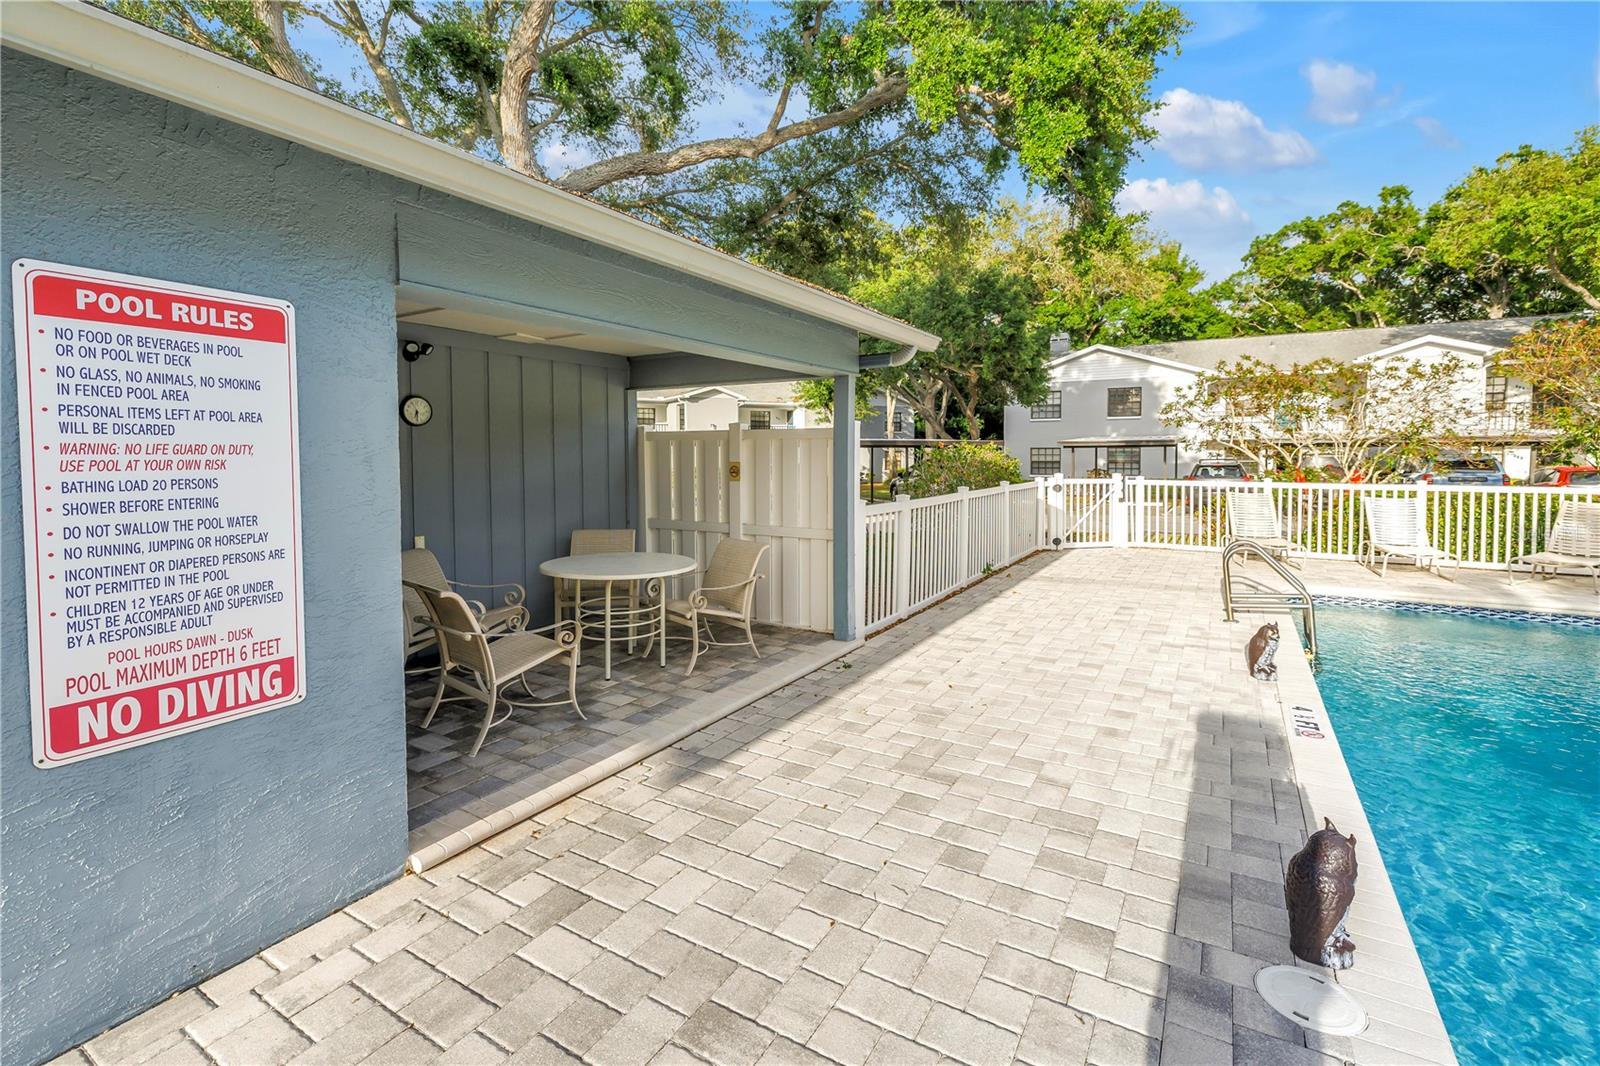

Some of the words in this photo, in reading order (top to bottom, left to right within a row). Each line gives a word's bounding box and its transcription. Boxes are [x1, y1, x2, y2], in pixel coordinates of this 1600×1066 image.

[76, 288, 162, 320] POOL
[171, 302, 254, 331] RULES
[54, 327, 74, 341] NO
[78, 330, 112, 344] FOOD
[116, 334, 134, 346] OR
[137, 336, 200, 353] BEVERAGES
[203, 344, 214, 355] IN
[217, 345, 243, 358] POOL
[56, 344, 74, 358] OR
[78, 347, 96, 359] ON
[101, 348, 134, 362] POOL
[136, 352, 160, 365] WET
[164, 354, 192, 367] DECK
[56, 366, 75, 379] NO
[79, 368, 121, 383] GLASS,
[126, 371, 142, 383] NO
[146, 372, 197, 388] ANIMALS,
[200, 376, 215, 388] NO
[218, 378, 261, 391] SMOKING
[57, 383, 70, 395] IN
[75, 384, 122, 398] FENCED
[126, 388, 158, 400] POOL
[161, 390, 190, 402] AREA
[58, 404, 124, 418] PERSONAL
[127, 407, 162, 420] ITEMS
[165, 409, 190, 421] LEFT
[194, 410, 206, 421] AT
[209, 411, 236, 422] POOL
[238, 412, 262, 423] AREA
[58, 422, 88, 434] WILL
[92, 423, 108, 435] BE
[112, 423, 175, 436] DISCARDED
[59, 443, 120, 455] WARNING:
[124, 444, 142, 455] NO
[146, 444, 169, 454] LIFE
[172, 444, 208, 455] GUARD
[211, 444, 226, 455] ON
[228, 445, 254, 456] DUTY,
[60, 460, 84, 472] USE
[88, 460, 121, 472] POOL
[124, 460, 139, 471] AT
[144, 460, 174, 471] YOUR
[176, 459, 202, 470] OWN
[204, 459, 226, 470] RISK
[61, 480, 115, 494] BATHING
[118, 480, 148, 492] LOAD
[152, 480, 167, 491] 20
[170, 478, 218, 490] PERSONS
[62, 501, 116, 516] SHOWER
[119, 499, 165, 514] BEFORE
[168, 497, 219, 512] ENTERING
[63, 527, 81, 540] DO
[86, 525, 110, 538] NOT
[114, 520, 170, 537] SWALLOW
[173, 519, 194, 532] THE
[197, 517, 224, 530] POOL
[226, 515, 258, 528] WATER
[64, 547, 82, 560] NO
[87, 542, 144, 558] RUNNING,
[148, 537, 194, 553] JUMPING
[197, 537, 212, 548] OR
[215, 532, 268, 547] HORSEPLAY
[64, 562, 146, 582] INCONTINENT
[150, 560, 165, 573] OR
[168, 555, 219, 571] DIAPERED
[222, 551, 266, 566] PERSONS
[268, 548, 285, 560] ARE
[65, 586, 91, 599] NOT
[95, 577, 160, 596] PERMITTED
[164, 576, 176, 588] IN
[179, 574, 200, 586] THE
[203, 570, 229, 583] POOL
[66, 600, 126, 619] CHILDREN
[132, 598, 145, 609] 12
[149, 593, 184, 607] YEARS
[187, 590, 201, 602] OF
[204, 588, 224, 600] AGE
[226, 585, 240, 596] OR
[242, 580, 274, 594] UNDER
[66, 618, 100, 633] MUST
[105, 615, 120, 628] BE
[124, 604, 200, 625] ACCOMPANIED
[204, 601, 224, 613] AND
[227, 592, 284, 609] SUPERVISED
[68, 636, 82, 649] BY
[86, 634, 96, 646] A
[100, 622, 177, 644] RESPONSIBLE
[180, 615, 212, 630] ADULT
[108, 650, 140, 664] POOL
[144, 642, 183, 658] HOURS
[187, 636, 216, 651] DAWN
[227, 628, 254, 643] DUSK
[66, 674, 111, 698] POOL
[116, 656, 187, 687] MAXIMUM
[192, 648, 235, 672] DEPTH
[240, 646, 248, 661] 6
[252, 638, 281, 659] FEET
[78, 696, 142, 744] NO
[158, 664, 282, 724] DIVING
